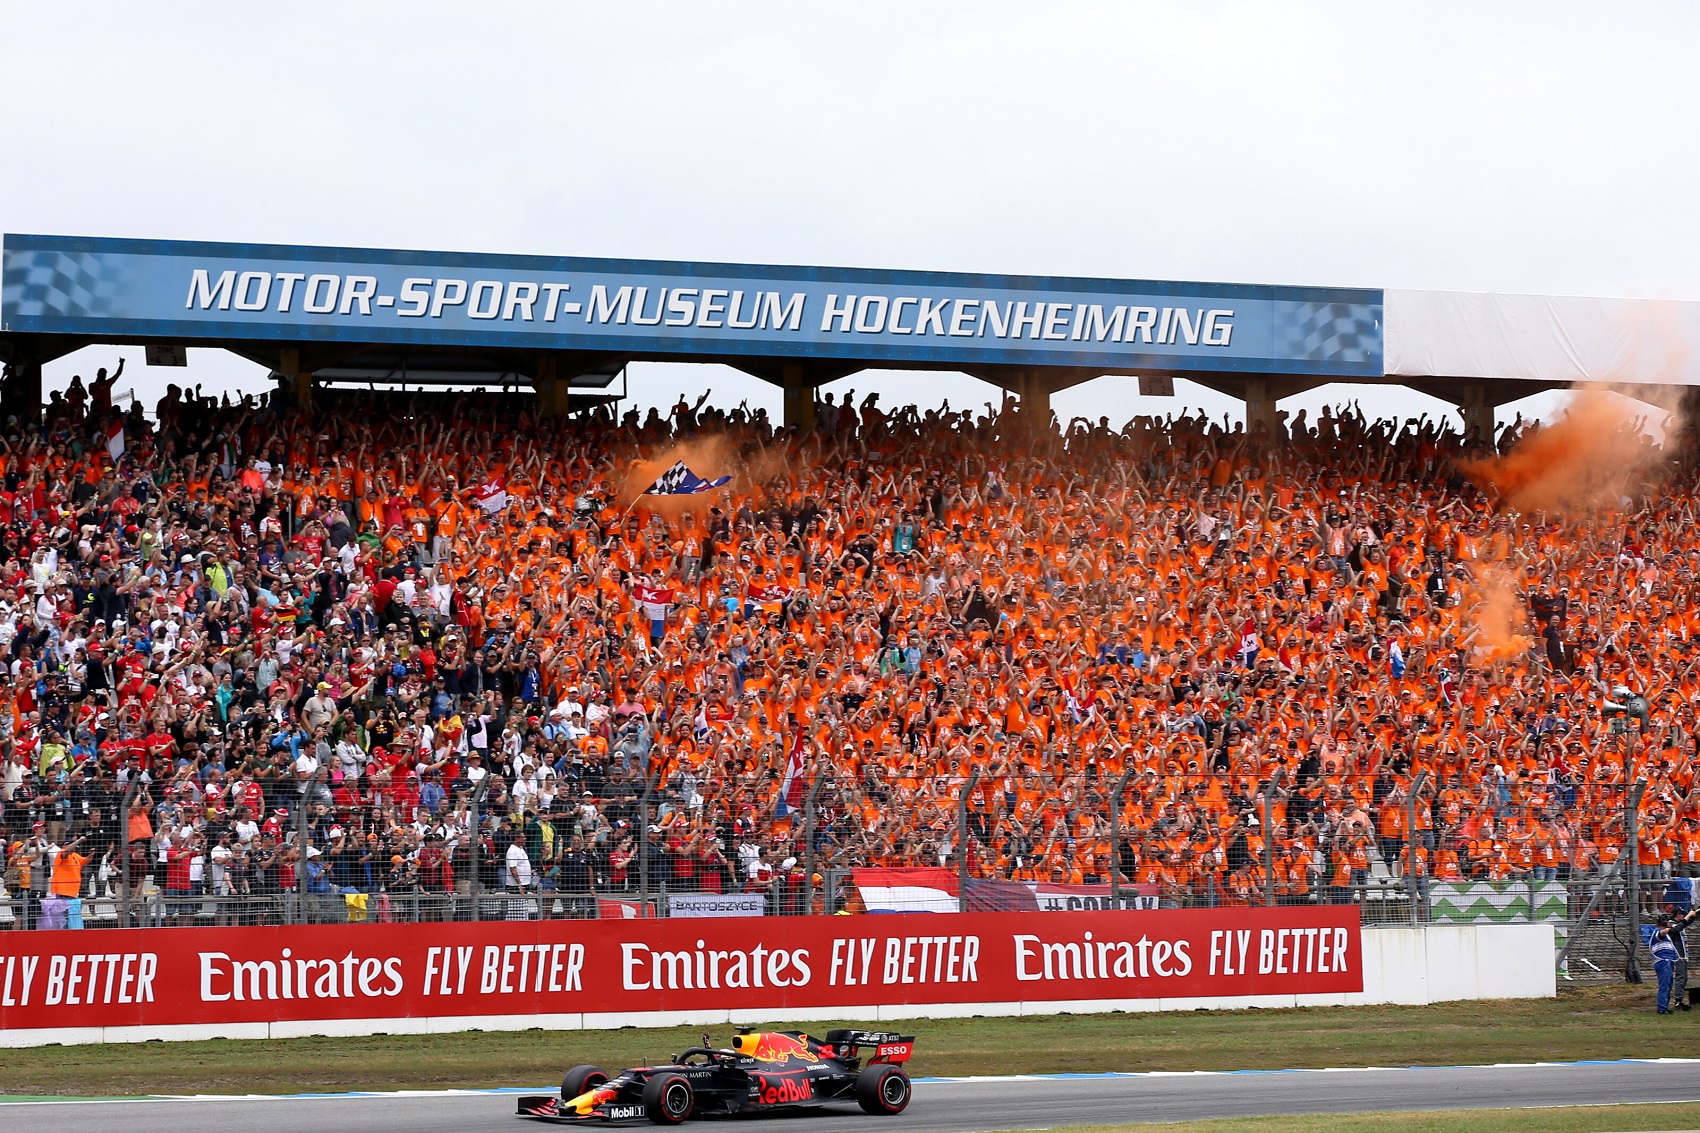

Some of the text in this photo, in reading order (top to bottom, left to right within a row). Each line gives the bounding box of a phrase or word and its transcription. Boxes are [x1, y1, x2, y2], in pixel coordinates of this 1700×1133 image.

[185, 269, 1235, 347] MOTOR-SPORT-MUSEUM HOCKENHEIMRING
[676, 901, 758, 911] BARTOSZYCE
[198, 947, 404, 1001] Emirates
[423, 943, 585, 996] FLY BETTER
[620, 939, 811, 991] Emirates
[829, 935, 980, 986] FLY BETTER
[1012, 931, 1192, 981] Emirates
[1208, 927, 1348, 976] FLY BETTER
[0, 953, 157, 1006] LY BETTER
[881, 1046, 907, 1056] ESSO
[611, 1106, 634, 1119] Mobil
